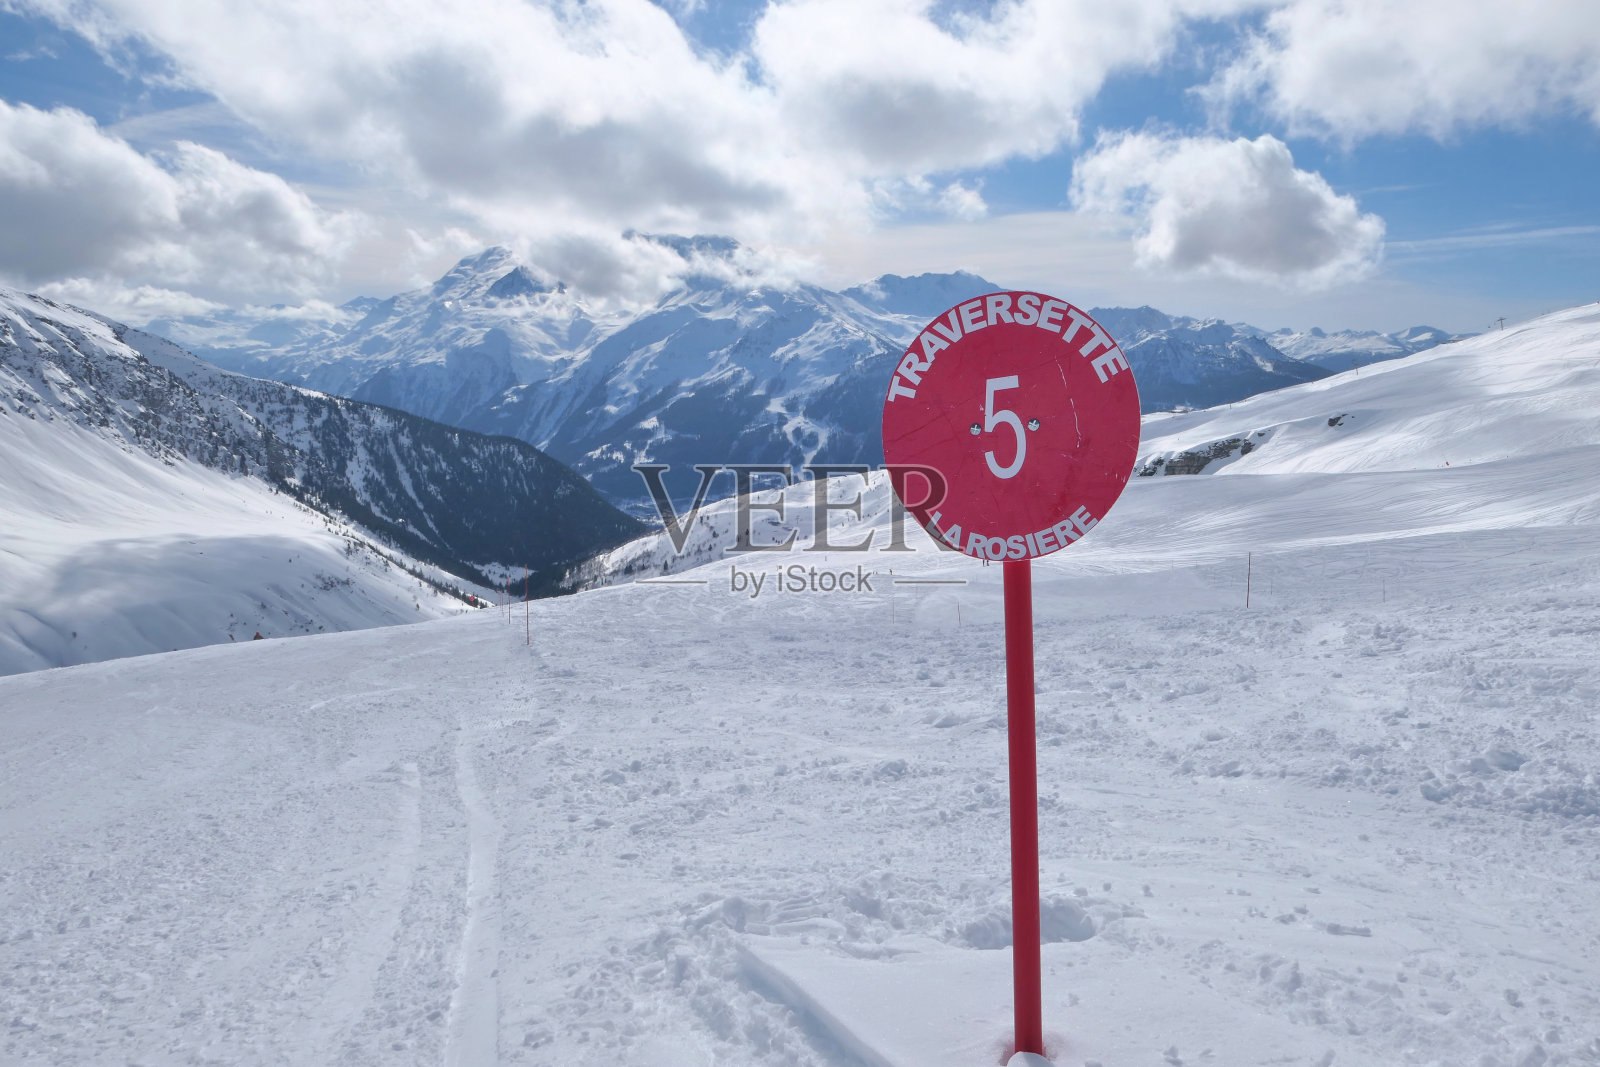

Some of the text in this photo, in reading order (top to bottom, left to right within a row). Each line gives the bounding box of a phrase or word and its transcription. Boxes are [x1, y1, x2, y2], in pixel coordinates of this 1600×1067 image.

[887, 294, 1129, 402] TRAVERSETTE
[984, 375, 1027, 479] 5
[925, 505, 1099, 561] LA ROSIERE
